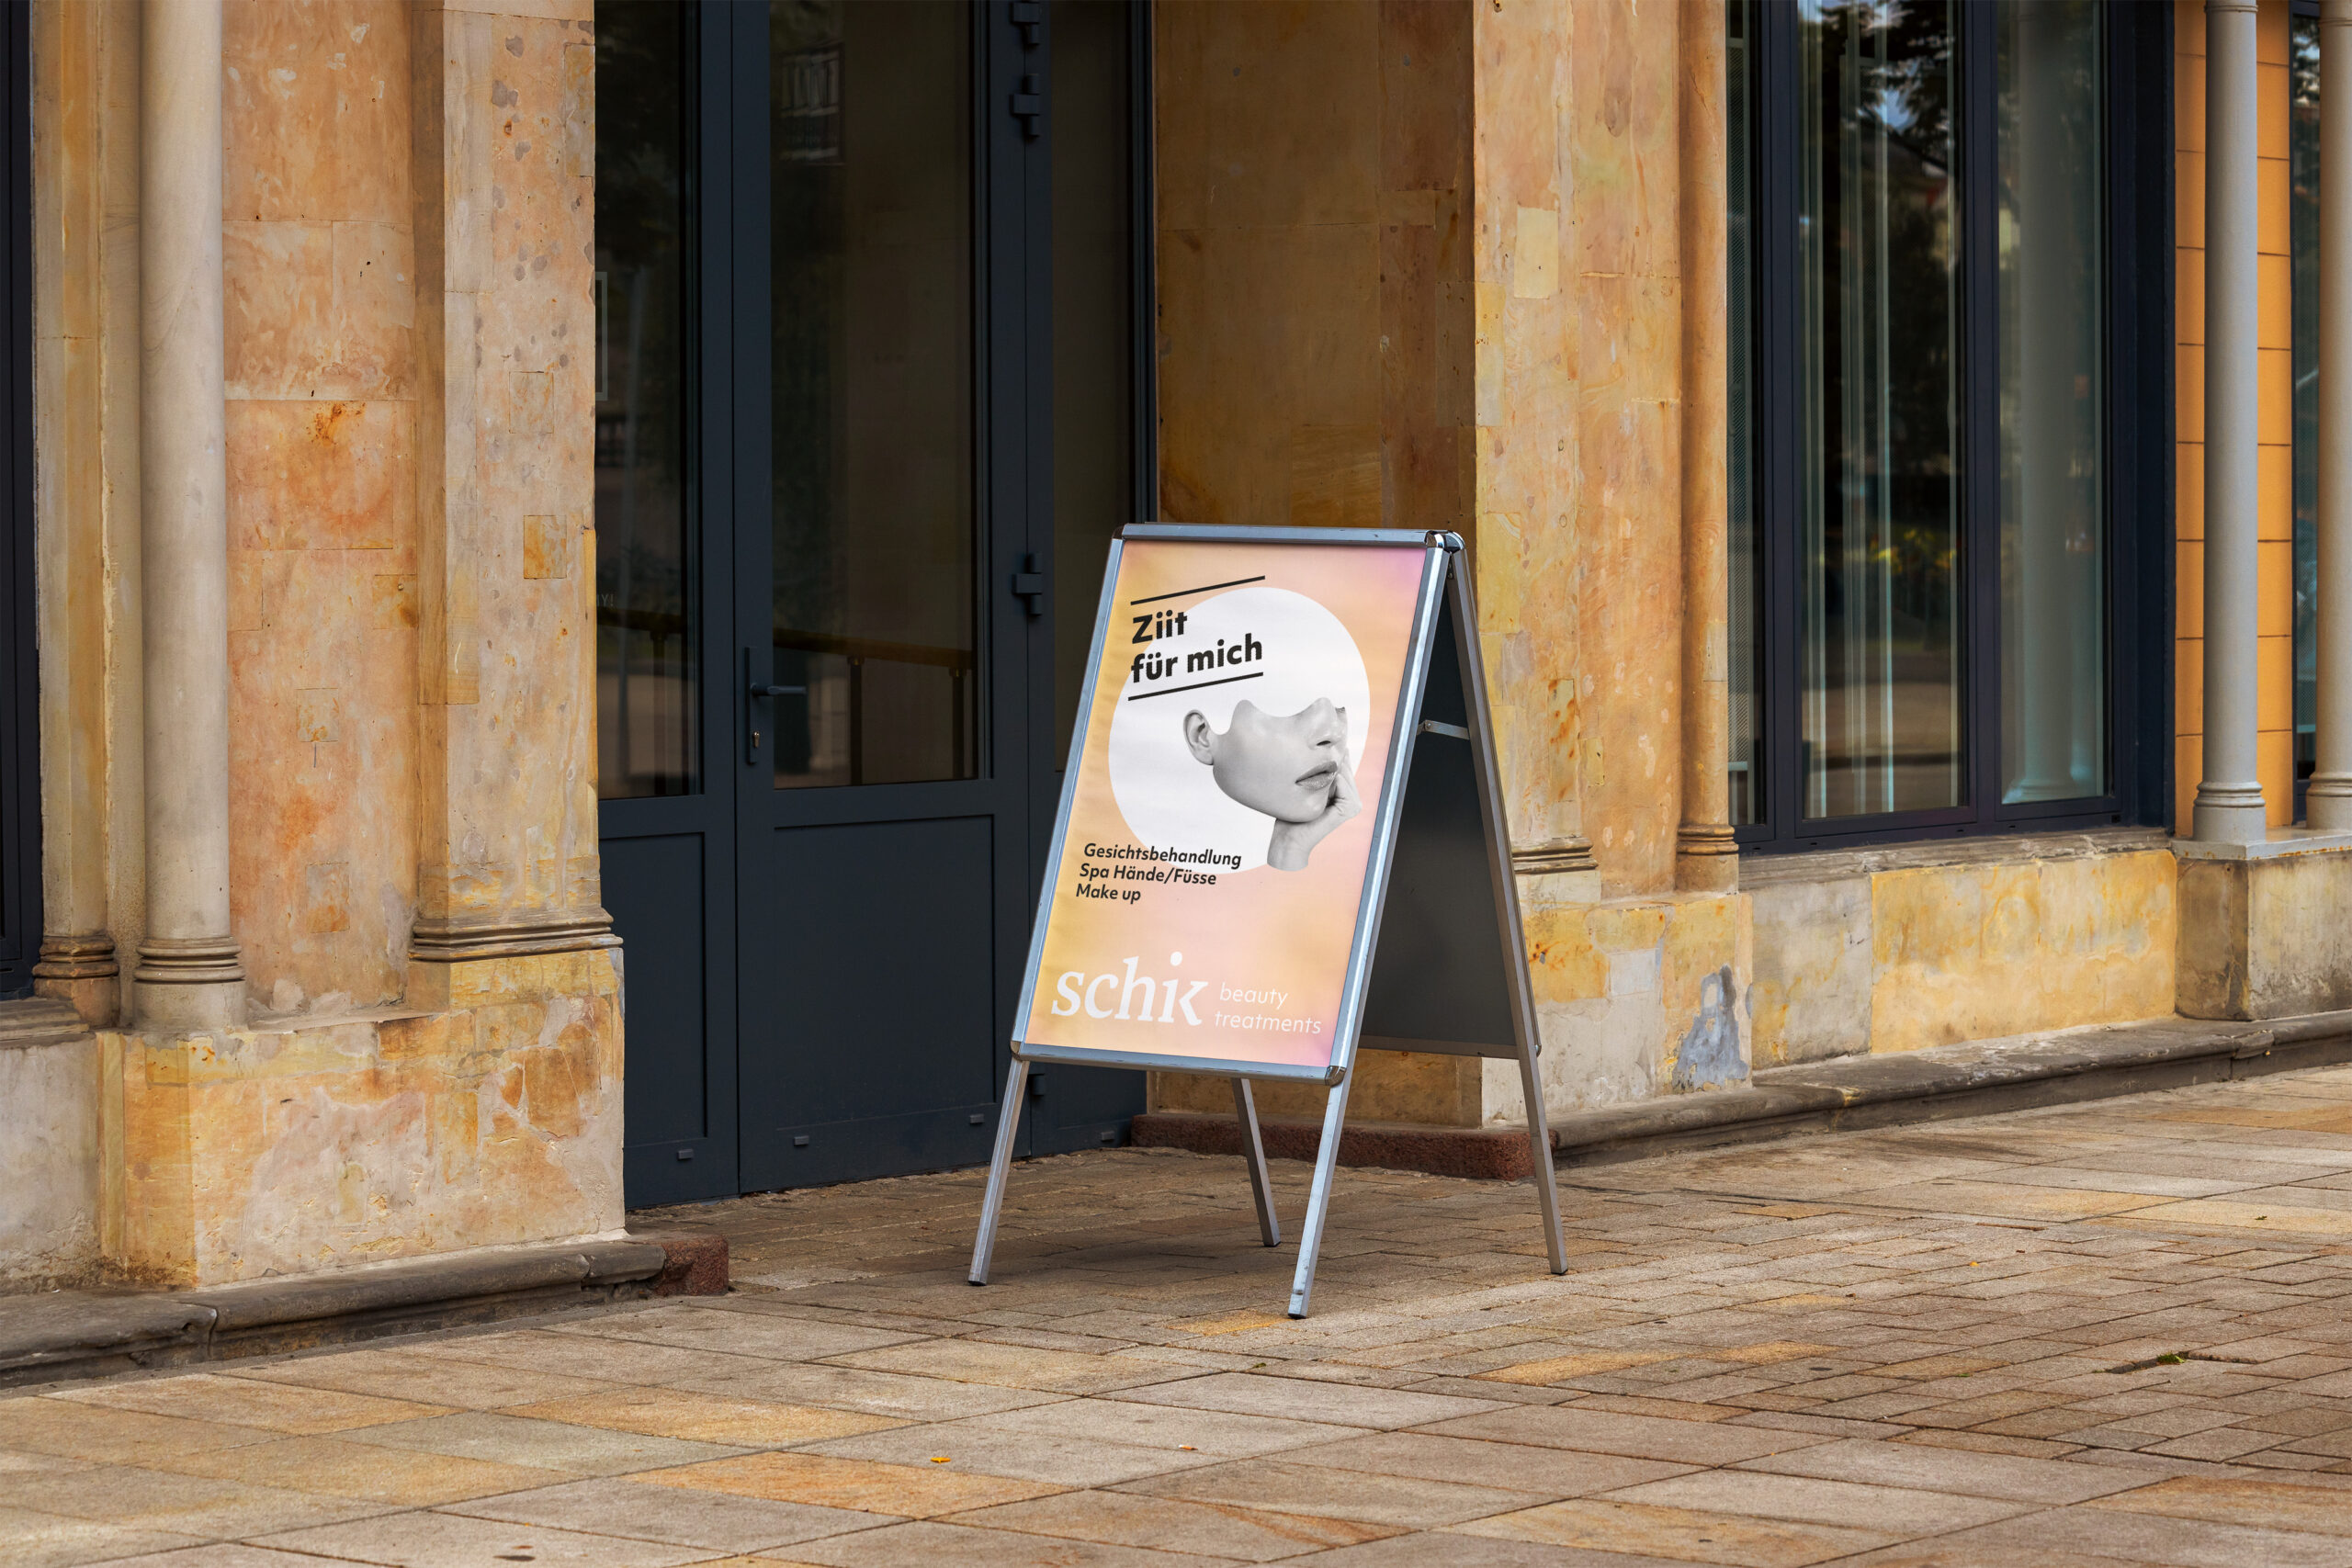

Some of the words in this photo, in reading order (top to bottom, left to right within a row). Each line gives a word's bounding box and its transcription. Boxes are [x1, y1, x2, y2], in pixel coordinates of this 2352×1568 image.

[1131, 609, 1188, 645] Ziit
[1130, 651, 1179, 683] für
[1187, 632, 1262, 673] mich
[1083, 842, 1242, 870] Gesichtsbehandlung
[1079, 863, 1110, 882] Spa
[1113, 864, 1217, 886] Hände/Füsse
[1075, 883, 1119, 900] Make
[1122, 890, 1141, 905] up
[1050, 951, 1209, 1026] schik
[1219, 981, 1289, 1010] beauty
[1215, 1010, 1322, 1035] treatments
